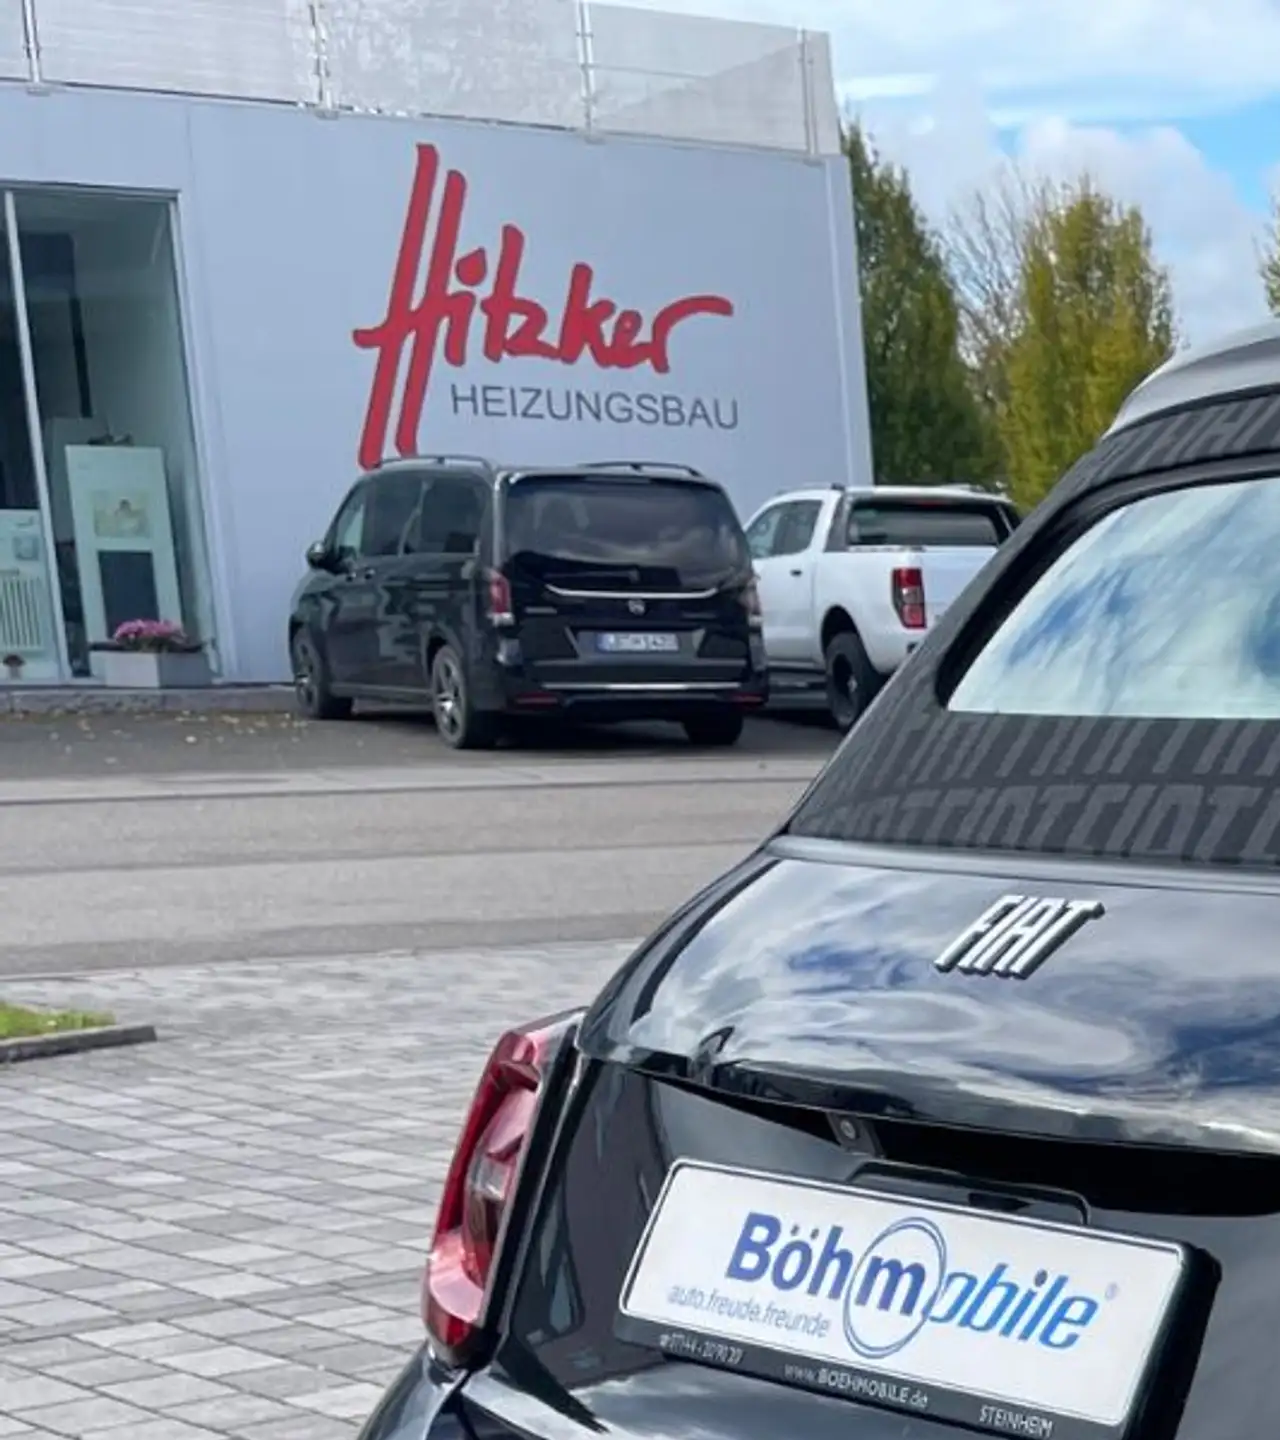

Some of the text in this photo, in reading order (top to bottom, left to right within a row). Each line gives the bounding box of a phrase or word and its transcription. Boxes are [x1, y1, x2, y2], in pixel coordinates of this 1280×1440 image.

[352, 143, 734, 472] Hitzker
[450, 382, 740, 431] HEIZUNGSBAU
[933, 894, 1105, 980] FIAT
[725, 1212, 1098, 1350] Böhmobile
[978, 1403, 1054, 1439] STEINHEIM
